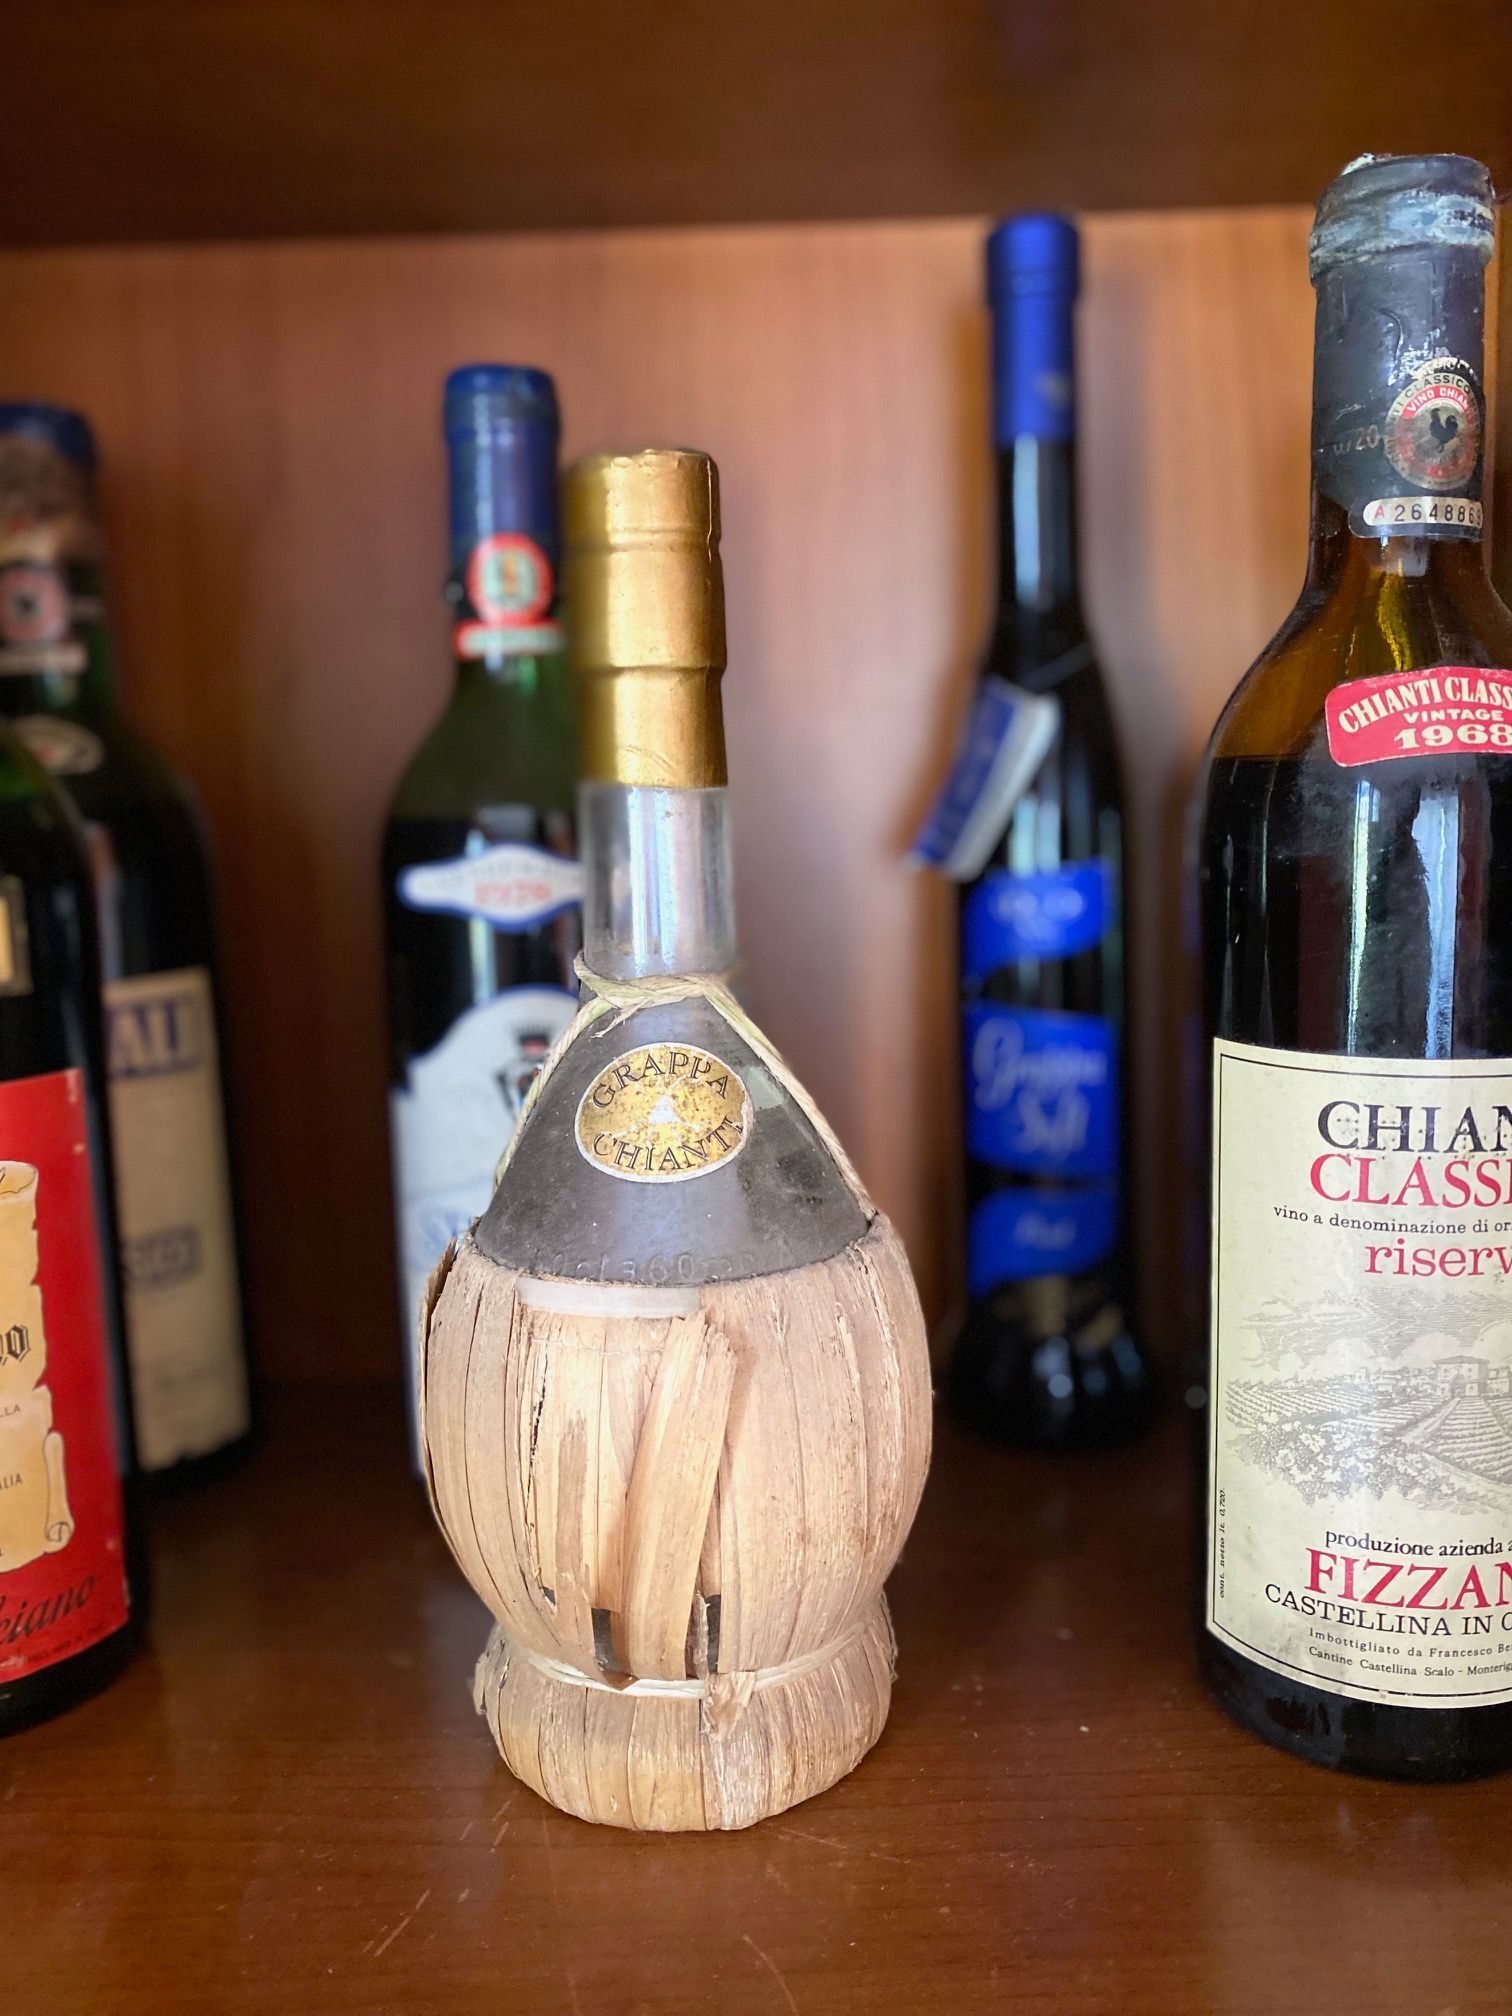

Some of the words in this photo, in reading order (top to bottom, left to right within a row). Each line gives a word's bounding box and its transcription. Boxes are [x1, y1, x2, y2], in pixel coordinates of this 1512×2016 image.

[1338, 679, 1440, 733] CHIANTI
[1403, 709, 1504, 724] VINTAGE
[1393, 724, 1512, 749] 1968
[593, 1051, 728, 1108] GRAPPA
[593, 1116, 744, 1171] CHIANTI
[1273, 1204, 1308, 1222] vino
[1313, 1214, 1323, 1224] a
[1329, 1213, 1466, 1234] denominazione
[1472, 1219, 1489, 1233] di
[1326, 1530, 1434, 1556] produzione
[1439, 1537, 1502, 1556] azienda
[1265, 1583, 1452, 1636] CASTELLINA
[1461, 1614, 1494, 1634] IN
[1309, 1627, 1400, 1655] Imbottigliato
[1407, 1647, 1422, 1657] da
[1429, 1647, 1493, 1658] Francesco
[1309, 1646, 1353, 1665] Cantine
[1360, 1659, 1417, 1676] Castellina
[1424, 1667, 1454, 1677] Scalo
